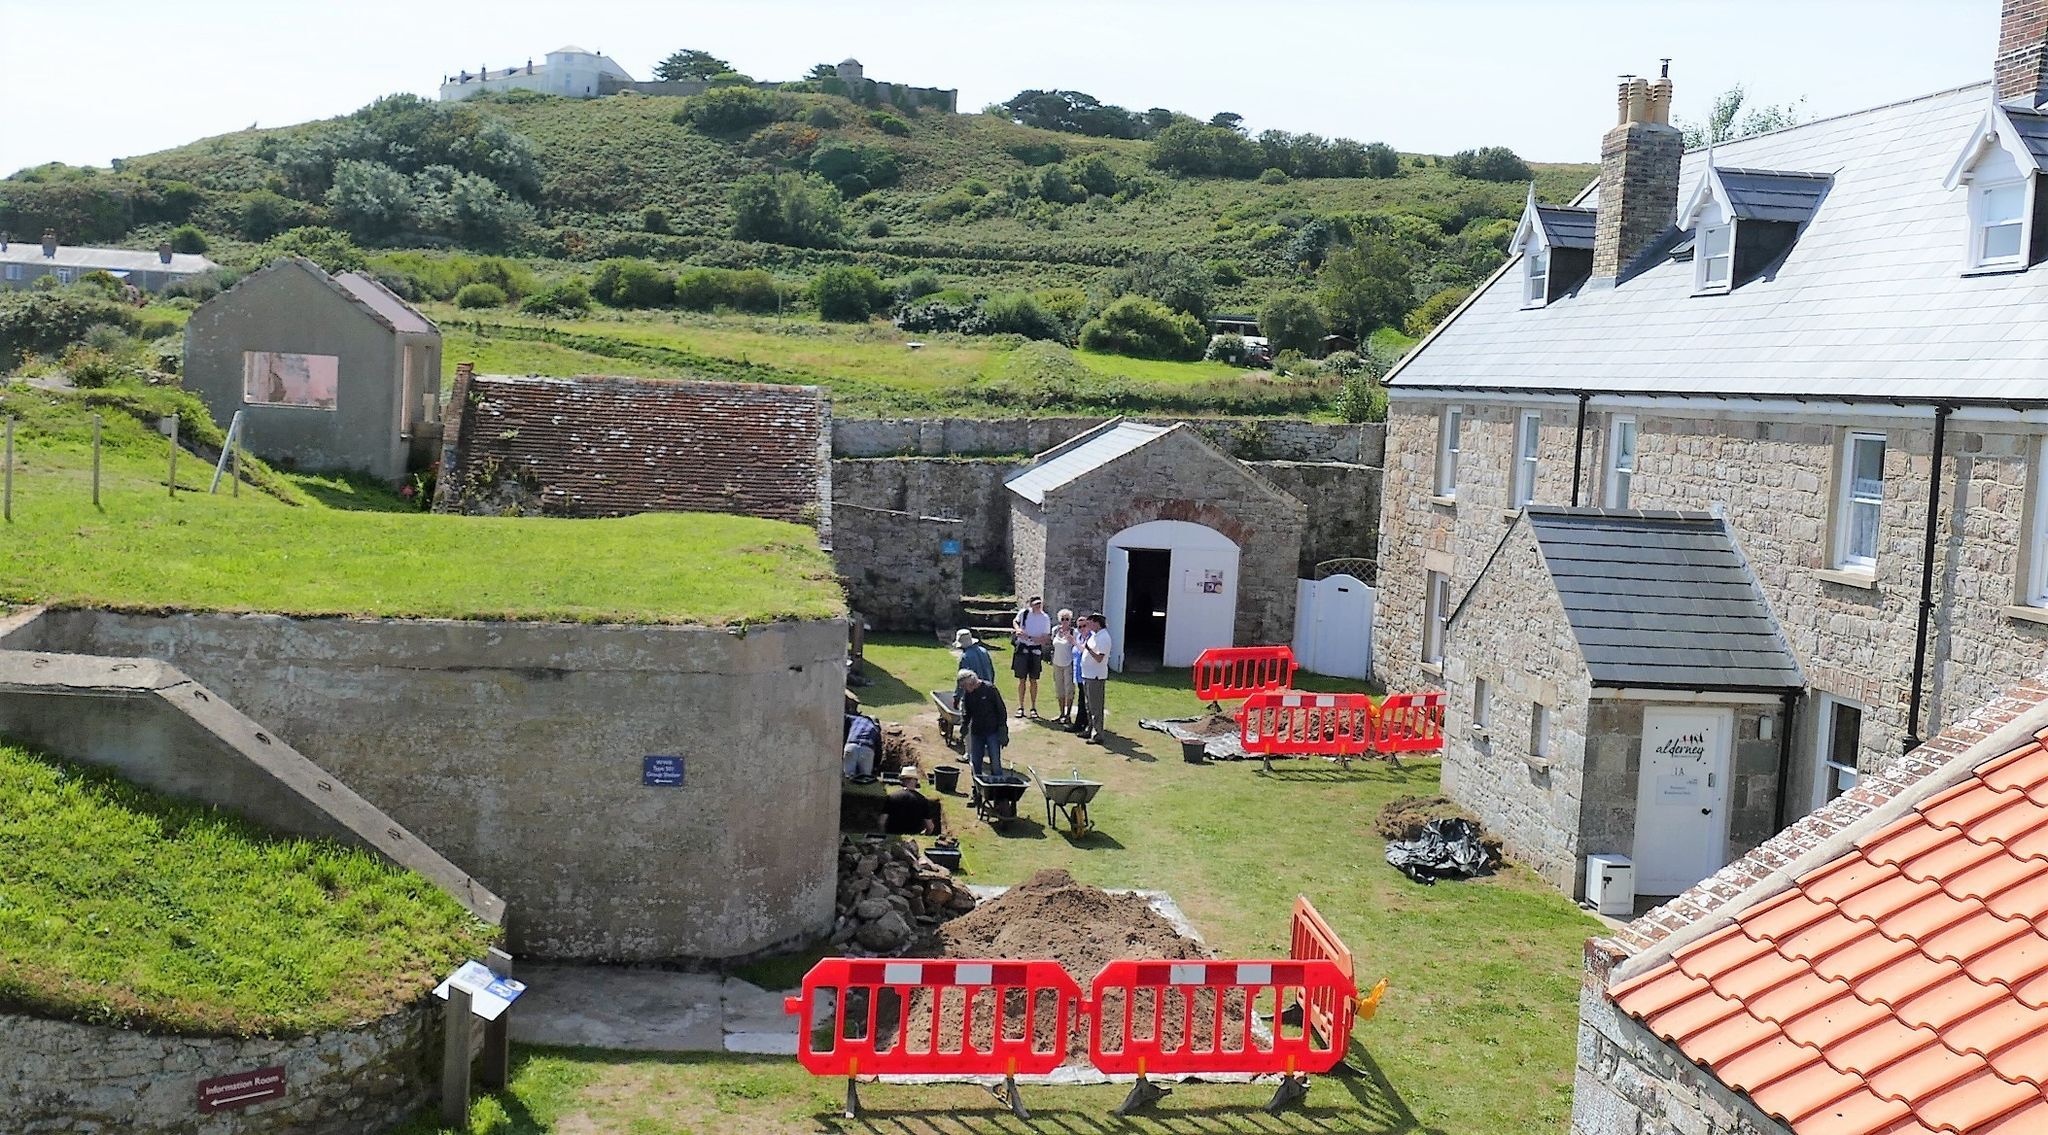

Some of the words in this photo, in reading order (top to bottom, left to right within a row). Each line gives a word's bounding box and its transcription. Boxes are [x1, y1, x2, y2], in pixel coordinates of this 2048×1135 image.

[1656, 738, 1704, 762] alderney
[206, 1081, 253, 1095] Information
[254, 1075, 279, 1086] Room
